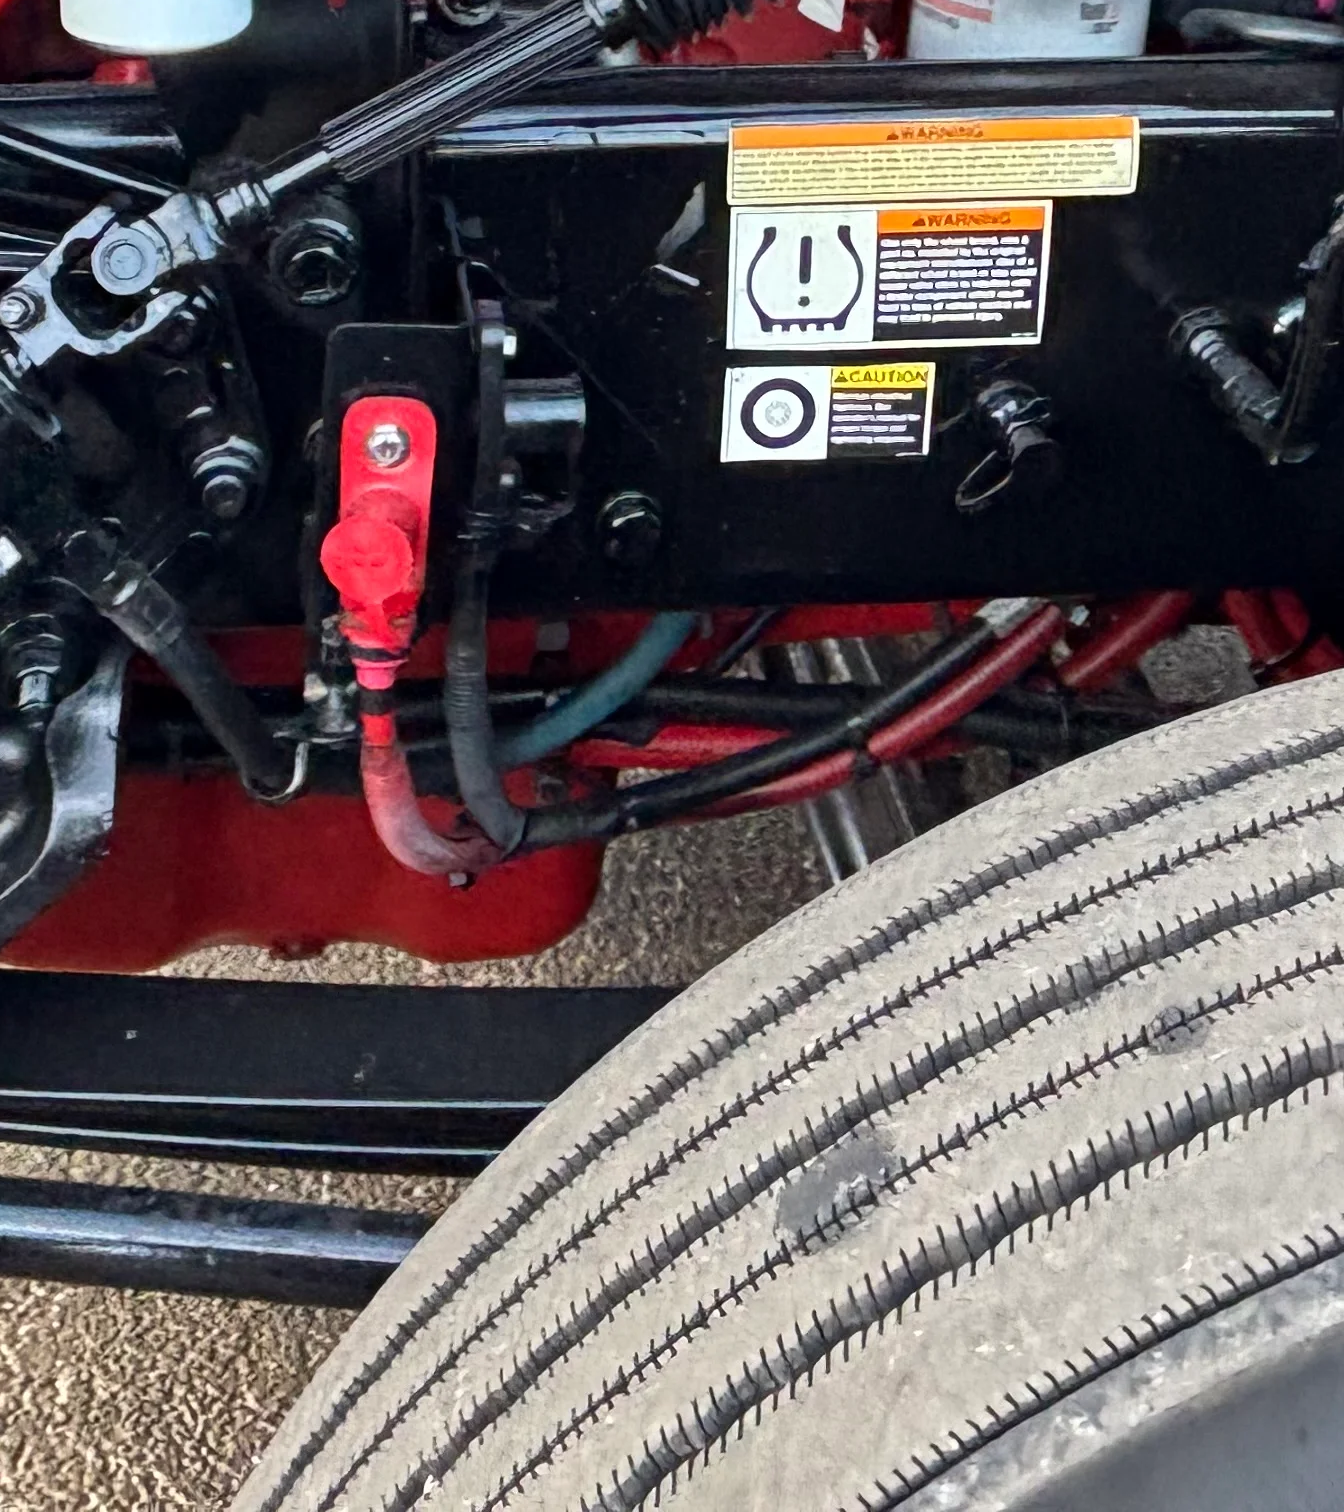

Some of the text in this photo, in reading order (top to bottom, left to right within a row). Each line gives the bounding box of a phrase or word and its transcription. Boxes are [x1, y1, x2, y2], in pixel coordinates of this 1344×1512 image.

[901, 124, 984, 141] WARNING
[927, 211, 1011, 227] WARNING
[849, 369, 929, 384] CAUTION
